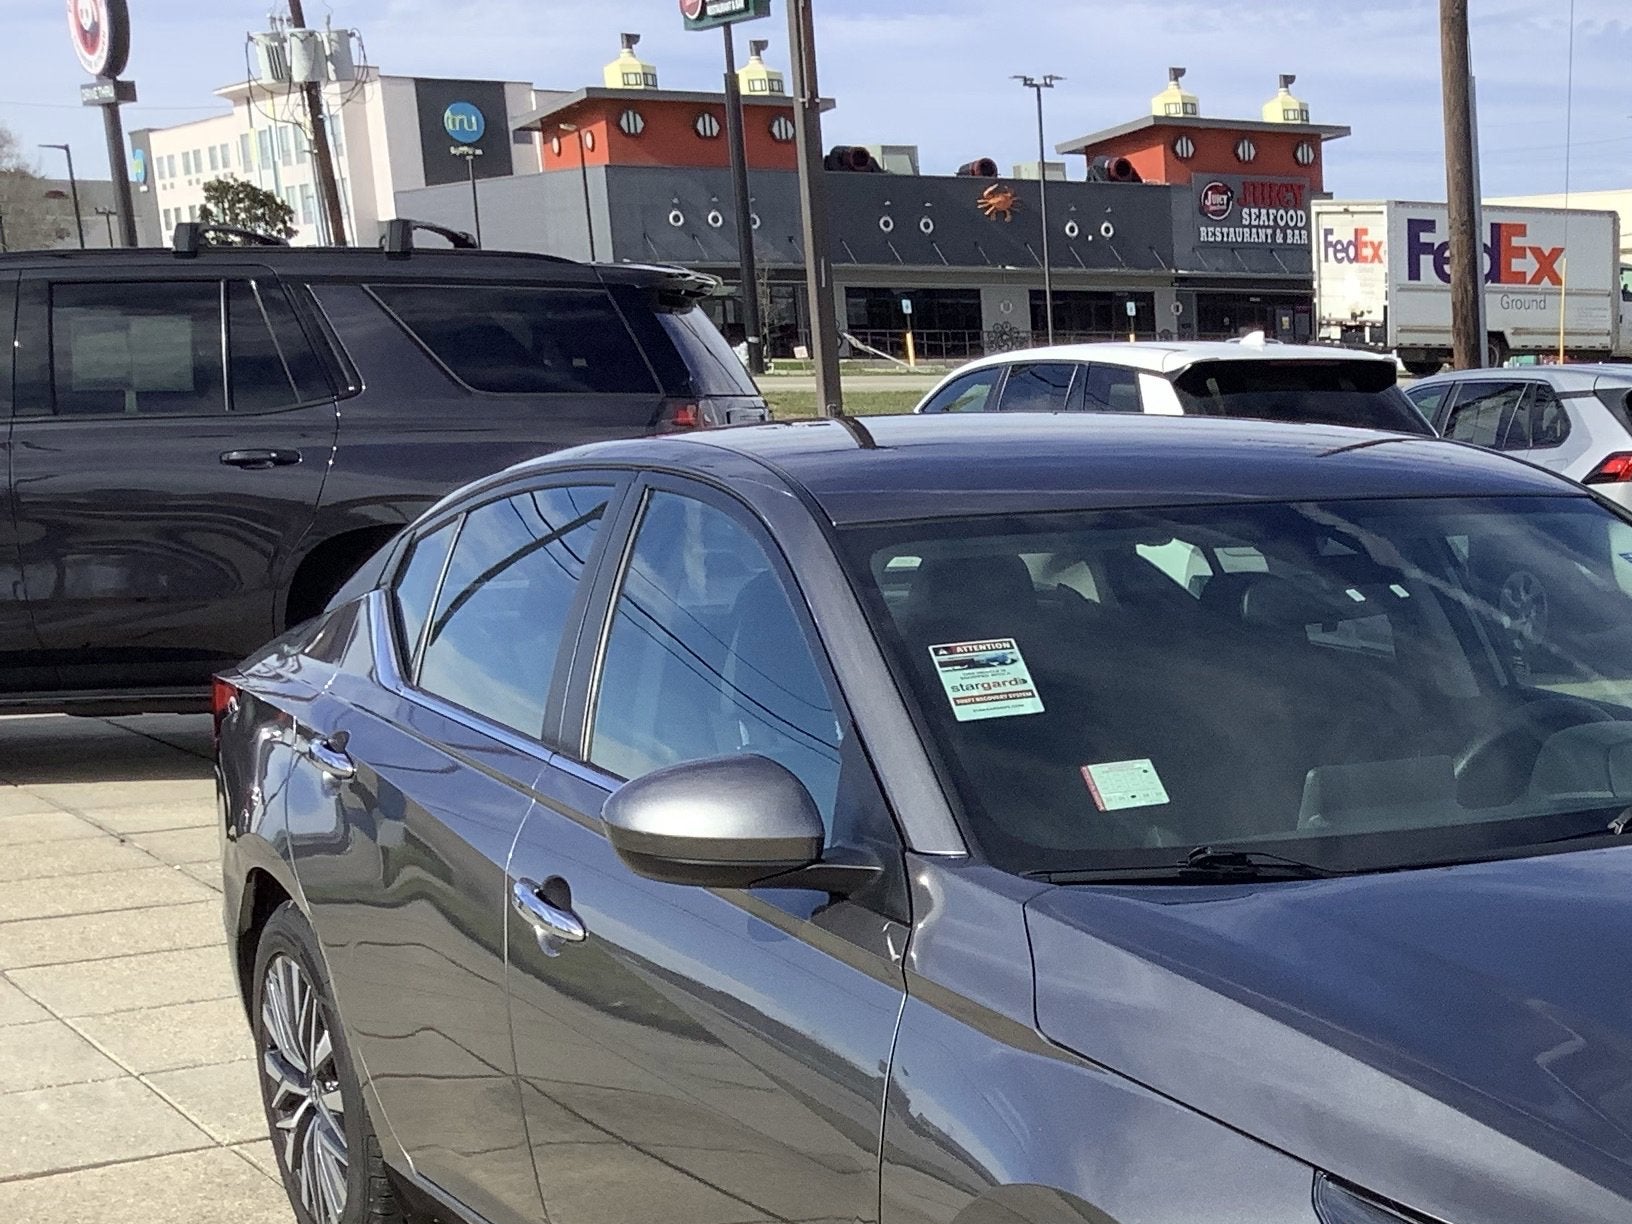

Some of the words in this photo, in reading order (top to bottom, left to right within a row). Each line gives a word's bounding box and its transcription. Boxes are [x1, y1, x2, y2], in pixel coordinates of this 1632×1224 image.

[1237, 181, 1305, 208] JUICY
[1241, 207, 1307, 227] SEAFOOD
[1199, 226, 1273, 243] RESTAURANT
[1275, 228, 1284, 244] &
[1286, 229, 1308, 244] BAR
[1323, 227, 1383, 264] FedEx
[1500, 293, 1547, 310] Ground
[956, 641, 1011, 653] ATTENTION
[950, 677, 1019, 692] stargard
